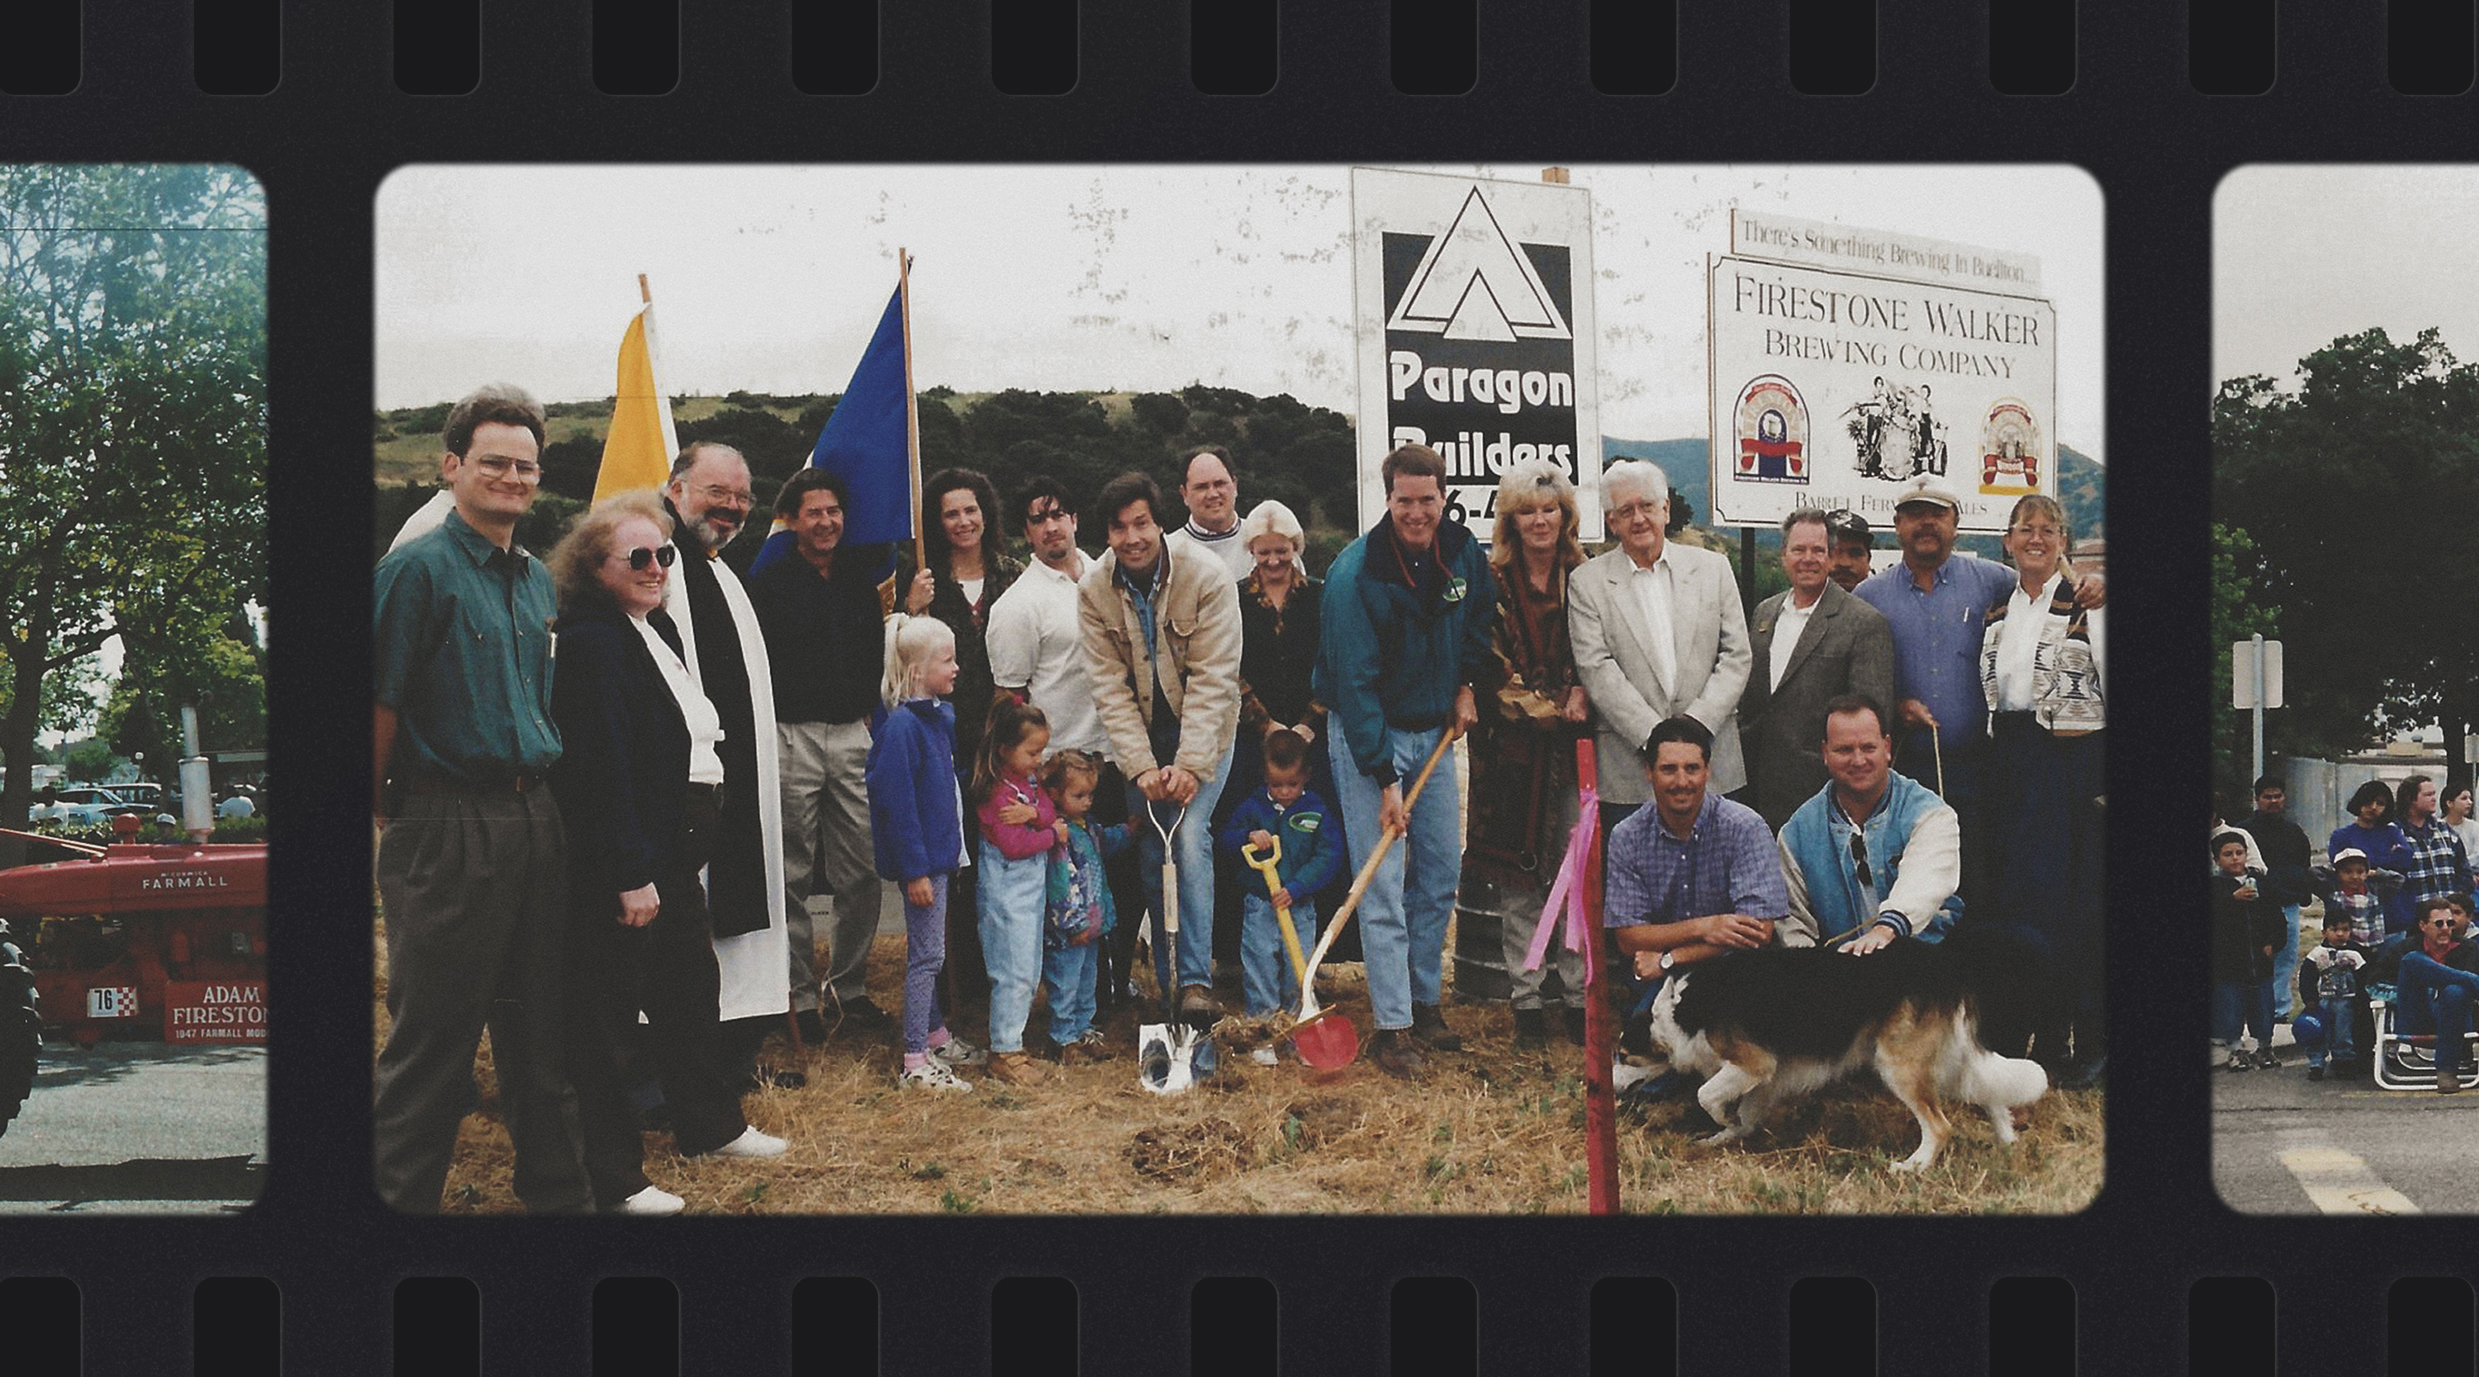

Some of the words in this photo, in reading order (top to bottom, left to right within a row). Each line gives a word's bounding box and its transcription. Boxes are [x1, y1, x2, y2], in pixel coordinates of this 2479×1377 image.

[1744, 220, 1799, 246] There's
[1804, 229, 1886, 264] Something
[1890, 243, 1950, 274] Brewing
[1955, 254, 1968, 274] In
[1735, 274, 1909, 331] FIRESTONE
[1924, 299, 2039, 346] WALKER
[1766, 328, 1888, 367] BREWING
[1899, 342, 2016, 379] COMPANY
[1390, 351, 1573, 414] Paragon
[142, 876, 228, 889] FARMALL
[94, 989, 112, 1010] 76
[203, 986, 261, 1004] ADAM
[176, 1030, 196, 1038] 1947
[201, 1029, 241, 1038] FARMALL
